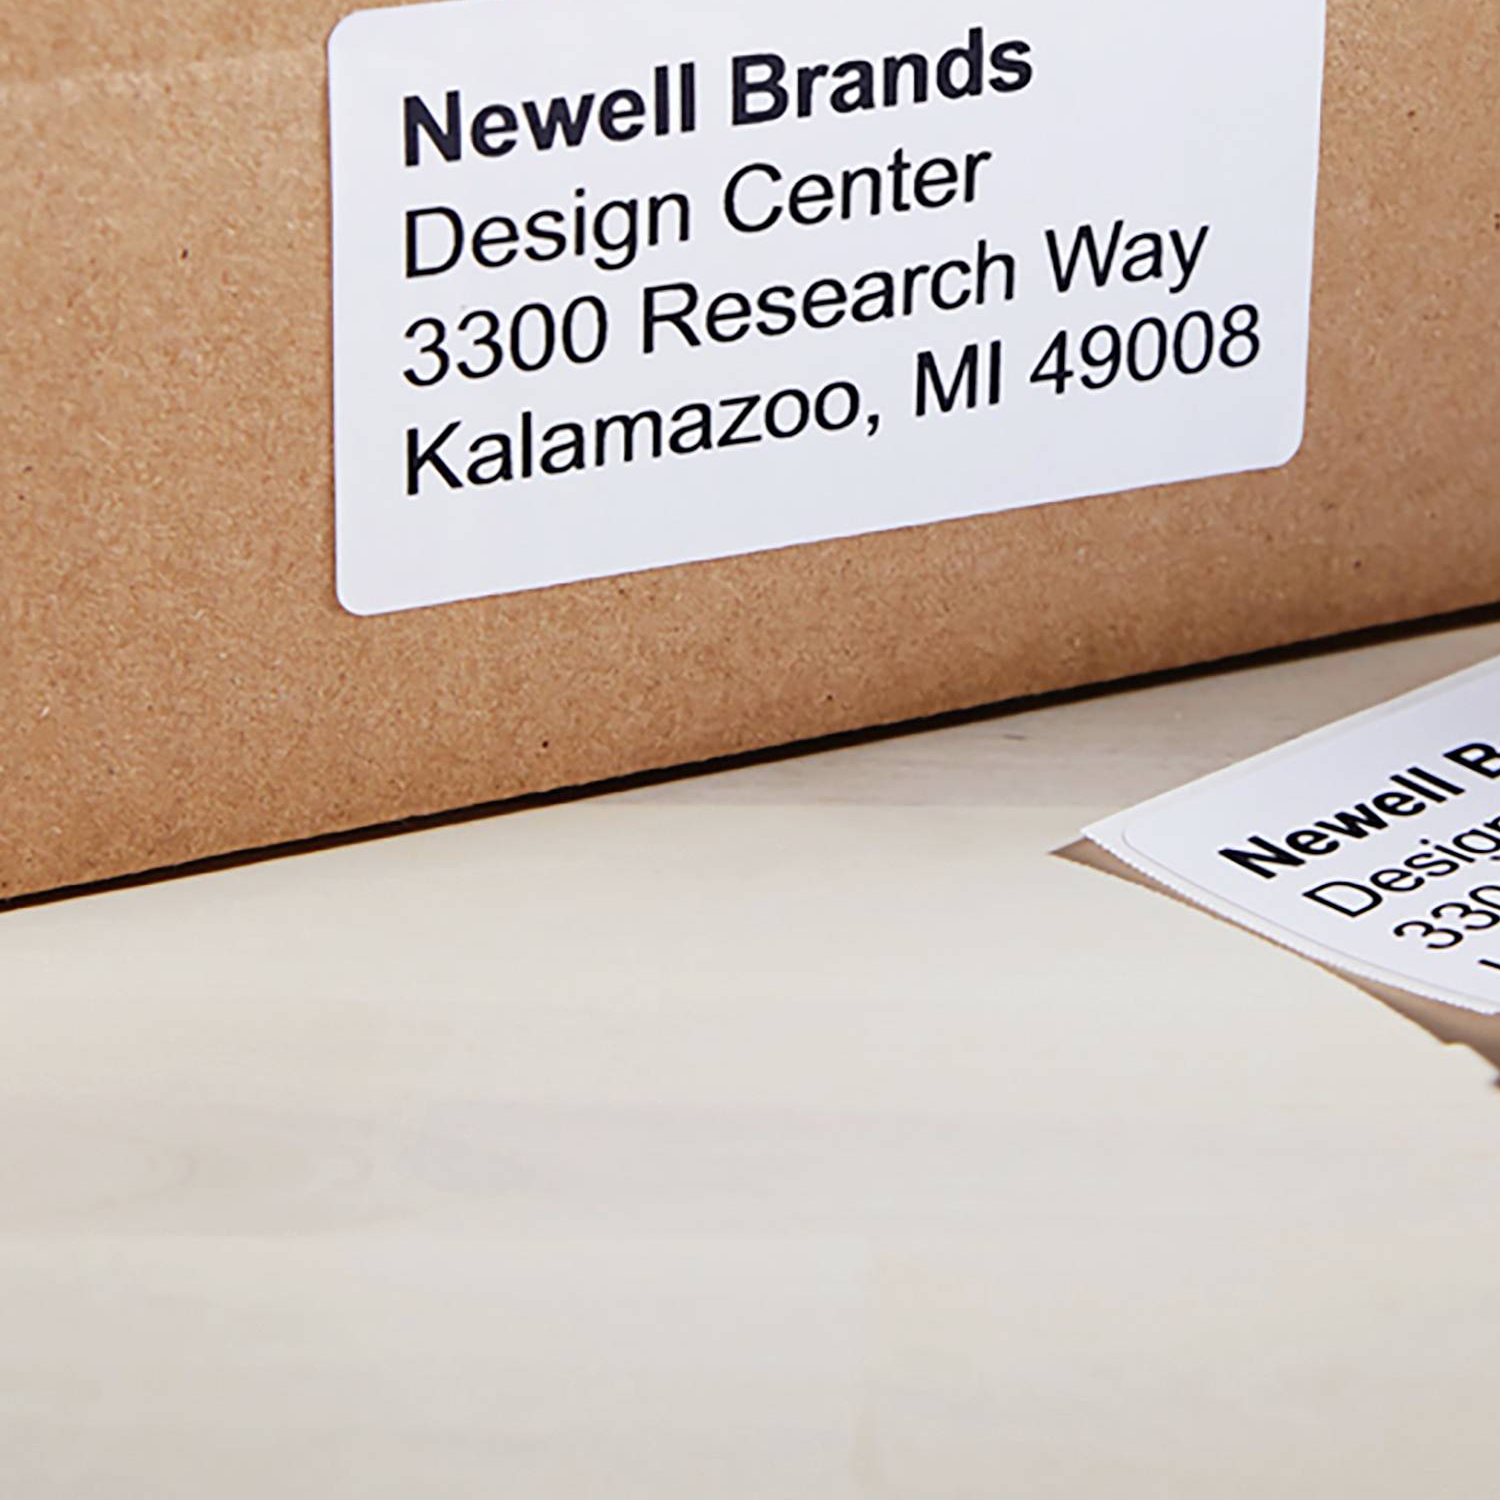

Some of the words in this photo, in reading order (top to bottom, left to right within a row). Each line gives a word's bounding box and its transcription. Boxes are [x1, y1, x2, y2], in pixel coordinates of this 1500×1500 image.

[404, 61, 696, 167] Newell
[732, 26, 1033, 126] Brands
[405, 189, 690, 279] Design
[724, 148, 992, 233] Center
[403, 295, 608, 387] 3300
[643, 239, 1015, 354] Research
[1045, 220, 1209, 294] Way
[407, 381, 879, 496] Kalamazoo,
[916, 340, 1001, 417] MI
[1030, 304, 1260, 395] 49008
[1218, 766, 1466, 879] Newell
